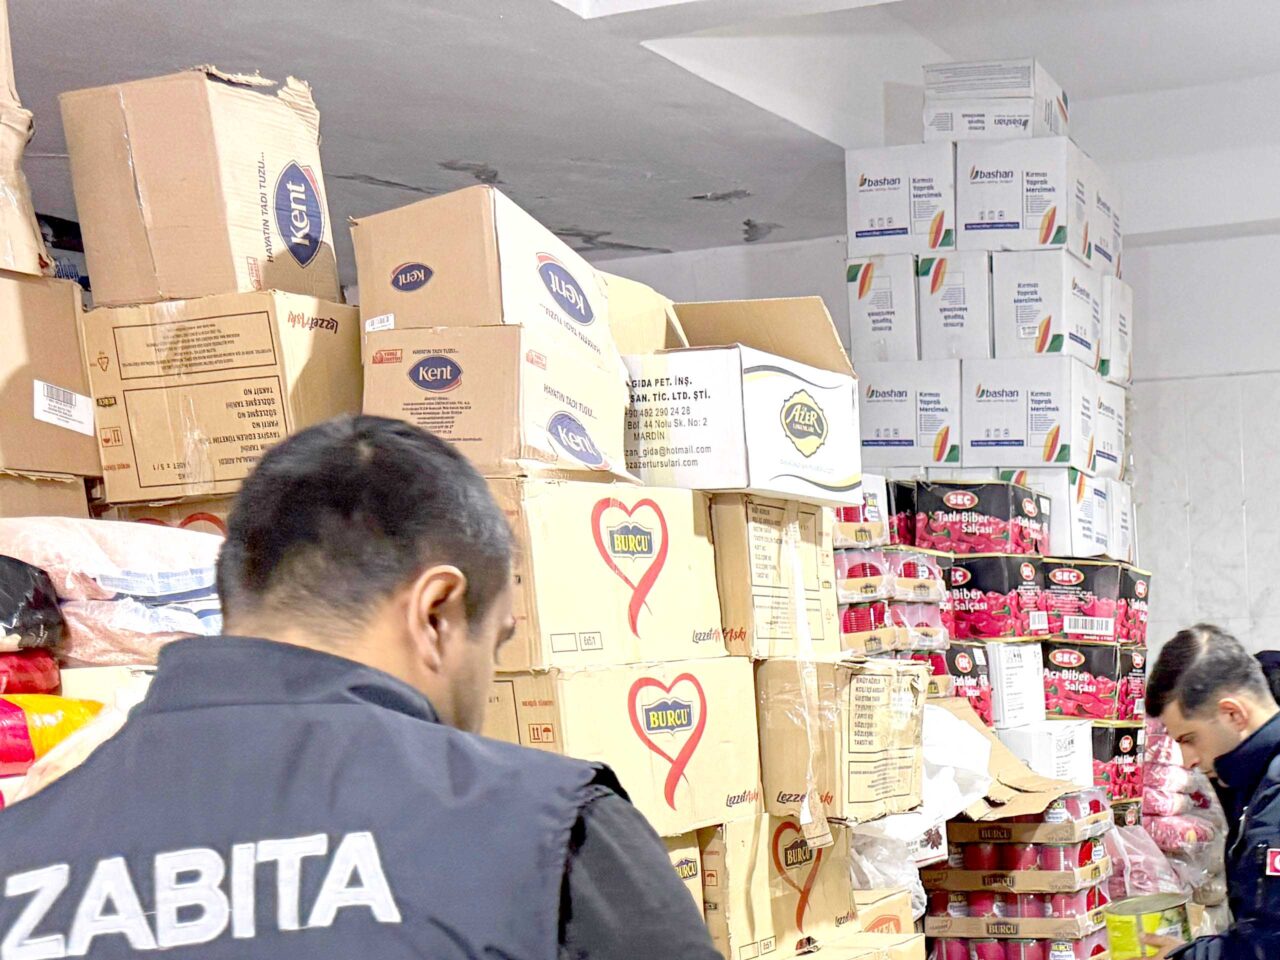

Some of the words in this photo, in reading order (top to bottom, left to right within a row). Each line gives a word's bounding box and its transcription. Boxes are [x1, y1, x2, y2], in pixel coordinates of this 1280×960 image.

[979, 169, 1014, 179] bashan
[868, 176, 901, 187] bashan
[260, 192, 269, 216] TADI
[285, 181, 311, 246] Kent
[262, 218, 274, 263] HAYATIN
[397, 268, 425, 287] Kent
[549, 269, 586, 316] Kent
[419, 365, 453, 382] Kent
[631, 379, 653, 388] GIDA
[654, 378, 673, 387] PET.
[674, 376, 692, 386] İNŞ.
[630, 394, 650, 403] SAN.
[652, 392, 671, 401] TİC.
[672, 391, 691, 401] LTD.
[693, 390, 711, 400] ŞTİ.
[875, 389, 907, 398] bashan
[985, 389, 1019, 398] bashan
[655, 407, 669, 417] 290
[670, 407, 680, 416] 24
[643, 419, 654, 428] 44
[702, 417, 708, 426] 2
[557, 423, 595, 457] Kent
[625, 444, 712, 459] zan_gida@hotmail.com
[625, 458, 698, 470] zazertursulari.com
[949, 494, 971, 507] SEÇ
[961, 511, 990, 523] Biber
[961, 524, 993, 536] Salçası
[1055, 572, 1077, 583] SEÇ
[953, 589, 982, 600] Biber
[954, 601, 987, 613] Salçası
[613, 633, 652, 652] BURCU
[1054, 653, 1079, 664] SEÇ
[1061, 669, 1089, 681] Biber
[1064, 681, 1097, 693] Salçası
[649, 709, 689, 729] BURCU
[982, 829, 1010, 839] BURCU
[787, 846, 812, 865] BURCU
[678, 862, 697, 879] URCU
[983, 875, 1014, 887] BURCU
[988, 923, 1018, 935] BURCU
